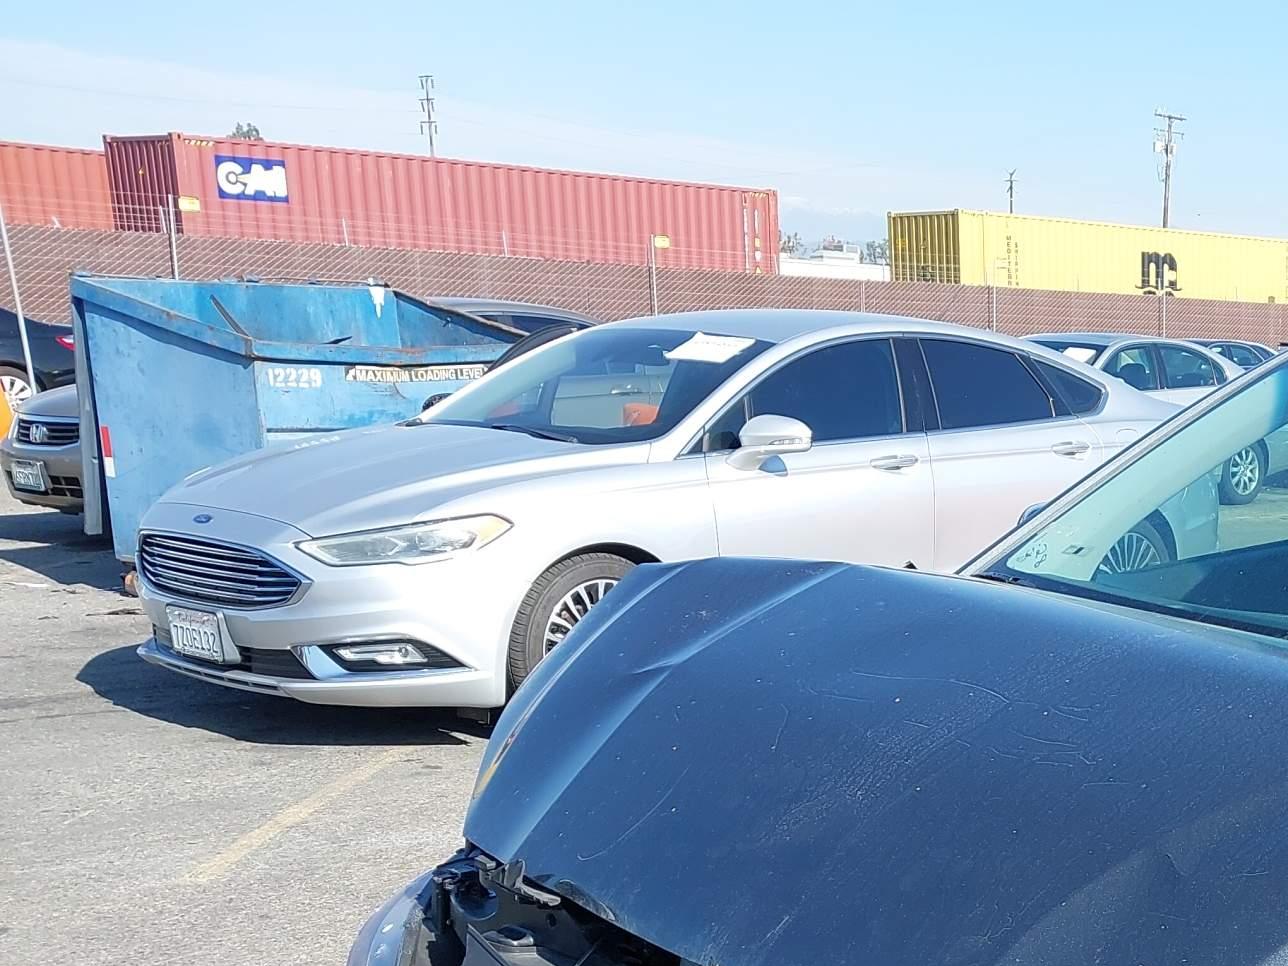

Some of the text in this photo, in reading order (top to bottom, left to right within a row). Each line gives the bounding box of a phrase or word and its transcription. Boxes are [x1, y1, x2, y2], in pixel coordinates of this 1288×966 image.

[217, 161, 288, 198] CAI
[267, 367, 322, 388] 12229
[355, 369, 410, 382] MAXIMUM
[412, 368, 456, 382] LOADING
